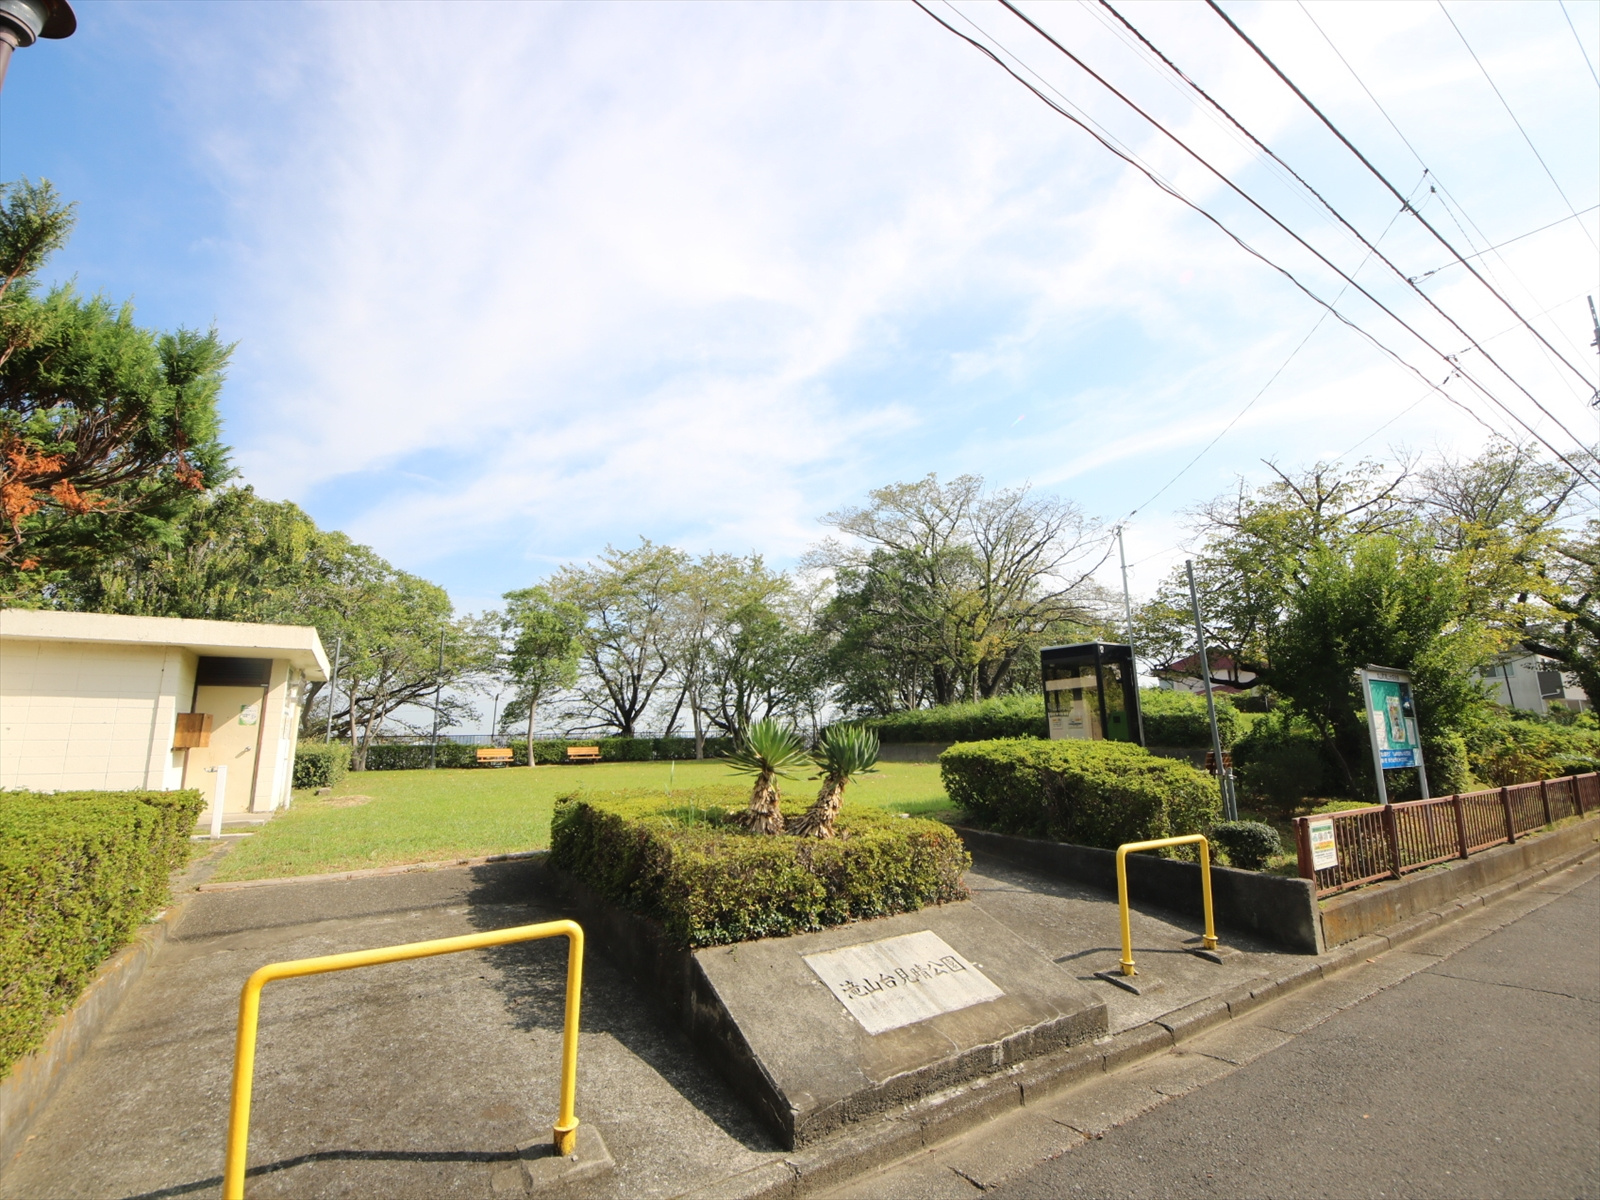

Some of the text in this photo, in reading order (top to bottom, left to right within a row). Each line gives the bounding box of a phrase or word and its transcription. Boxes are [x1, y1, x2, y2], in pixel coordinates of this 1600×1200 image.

[839, 955, 966, 999] 滝山台見晴公園
